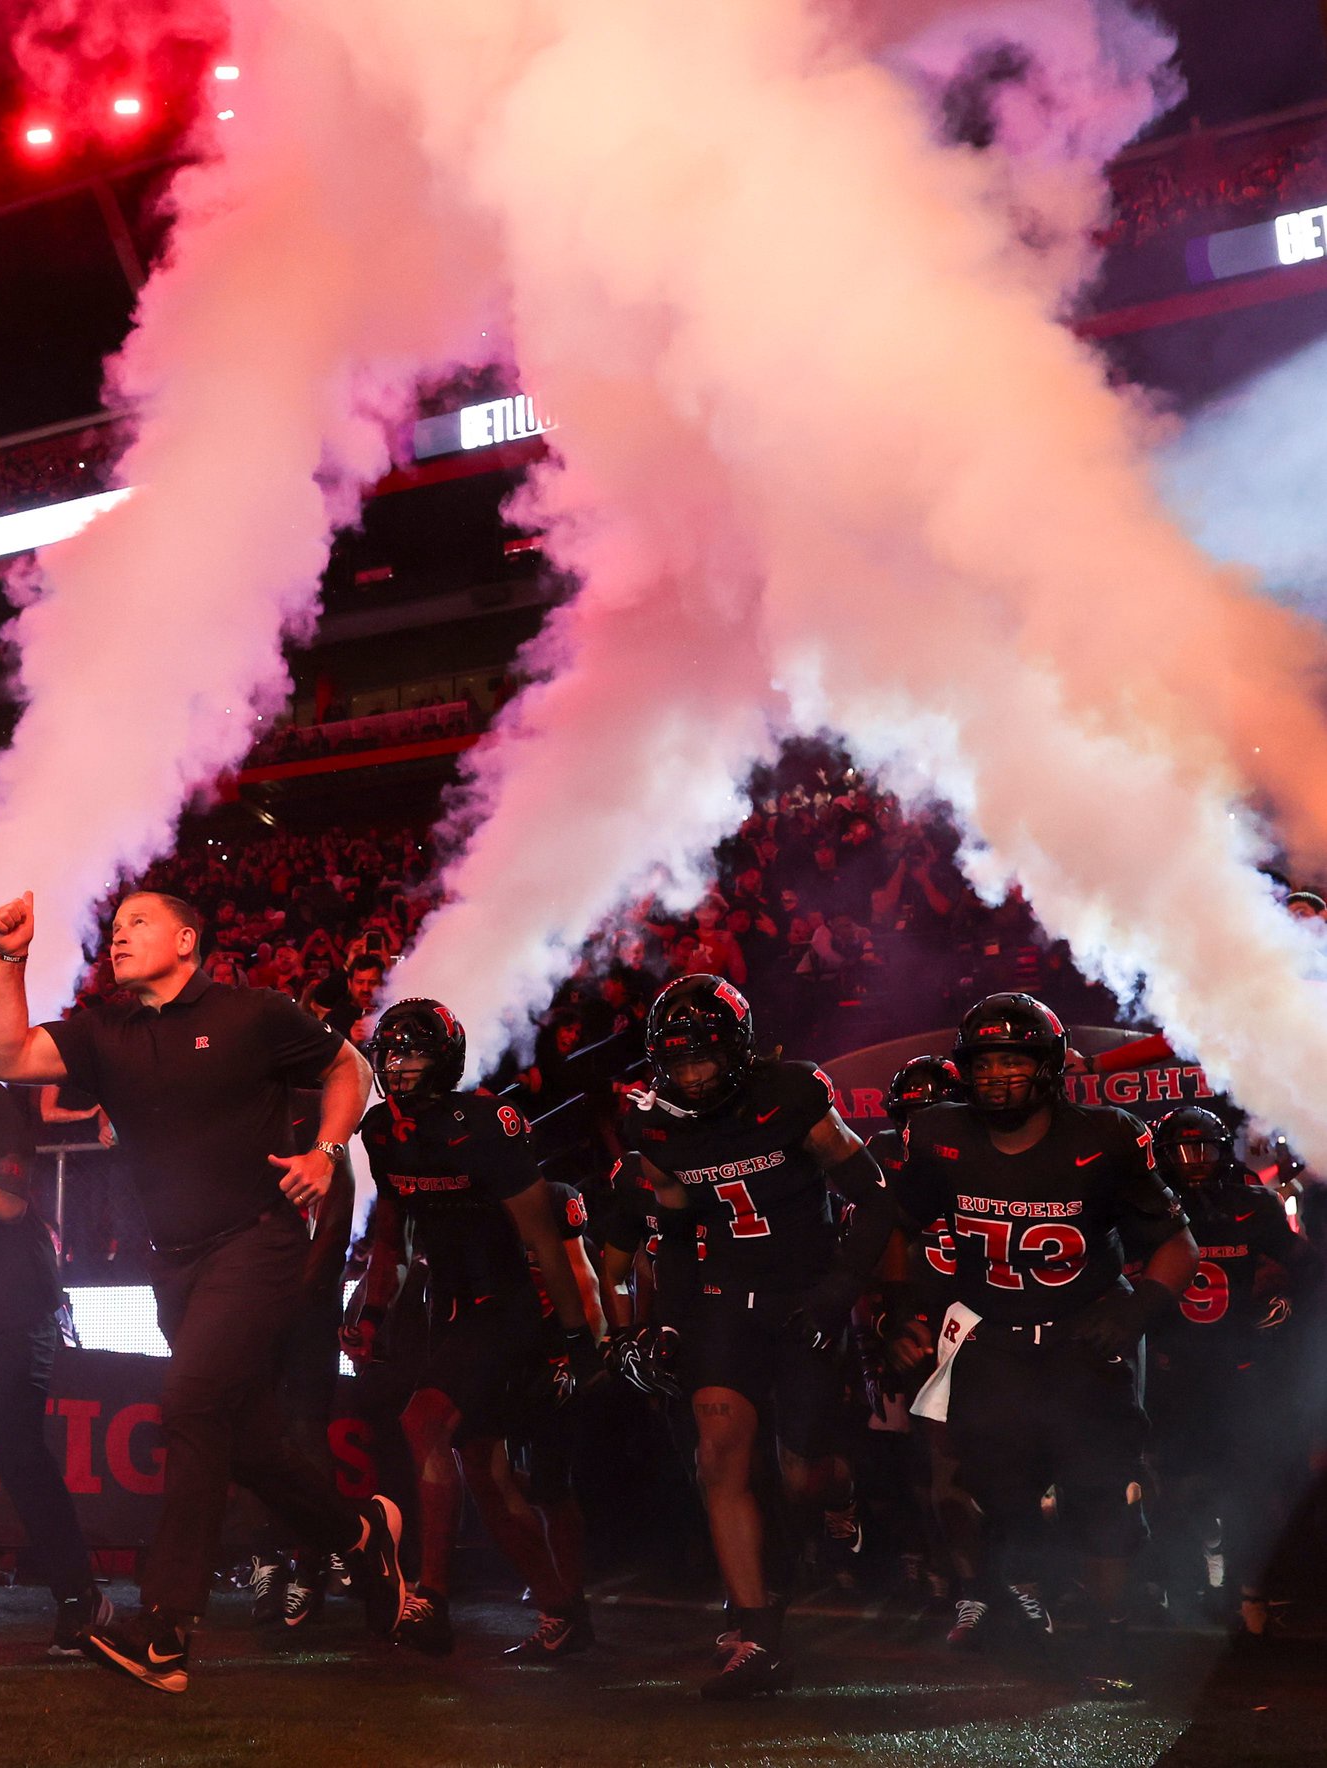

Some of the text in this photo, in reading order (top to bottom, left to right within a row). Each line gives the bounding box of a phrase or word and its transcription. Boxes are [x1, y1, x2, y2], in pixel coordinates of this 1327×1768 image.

[195, 1036, 210, 1049] R
[674, 1150, 786, 1185] RUTGERS
[714, 1179, 771, 1238] 1
[957, 1194, 1083, 1218] RUTGERS
[954, 1213, 1088, 1291] 73
[1179, 1261, 1229, 1323] 9
[944, 1318, 961, 1344] R
